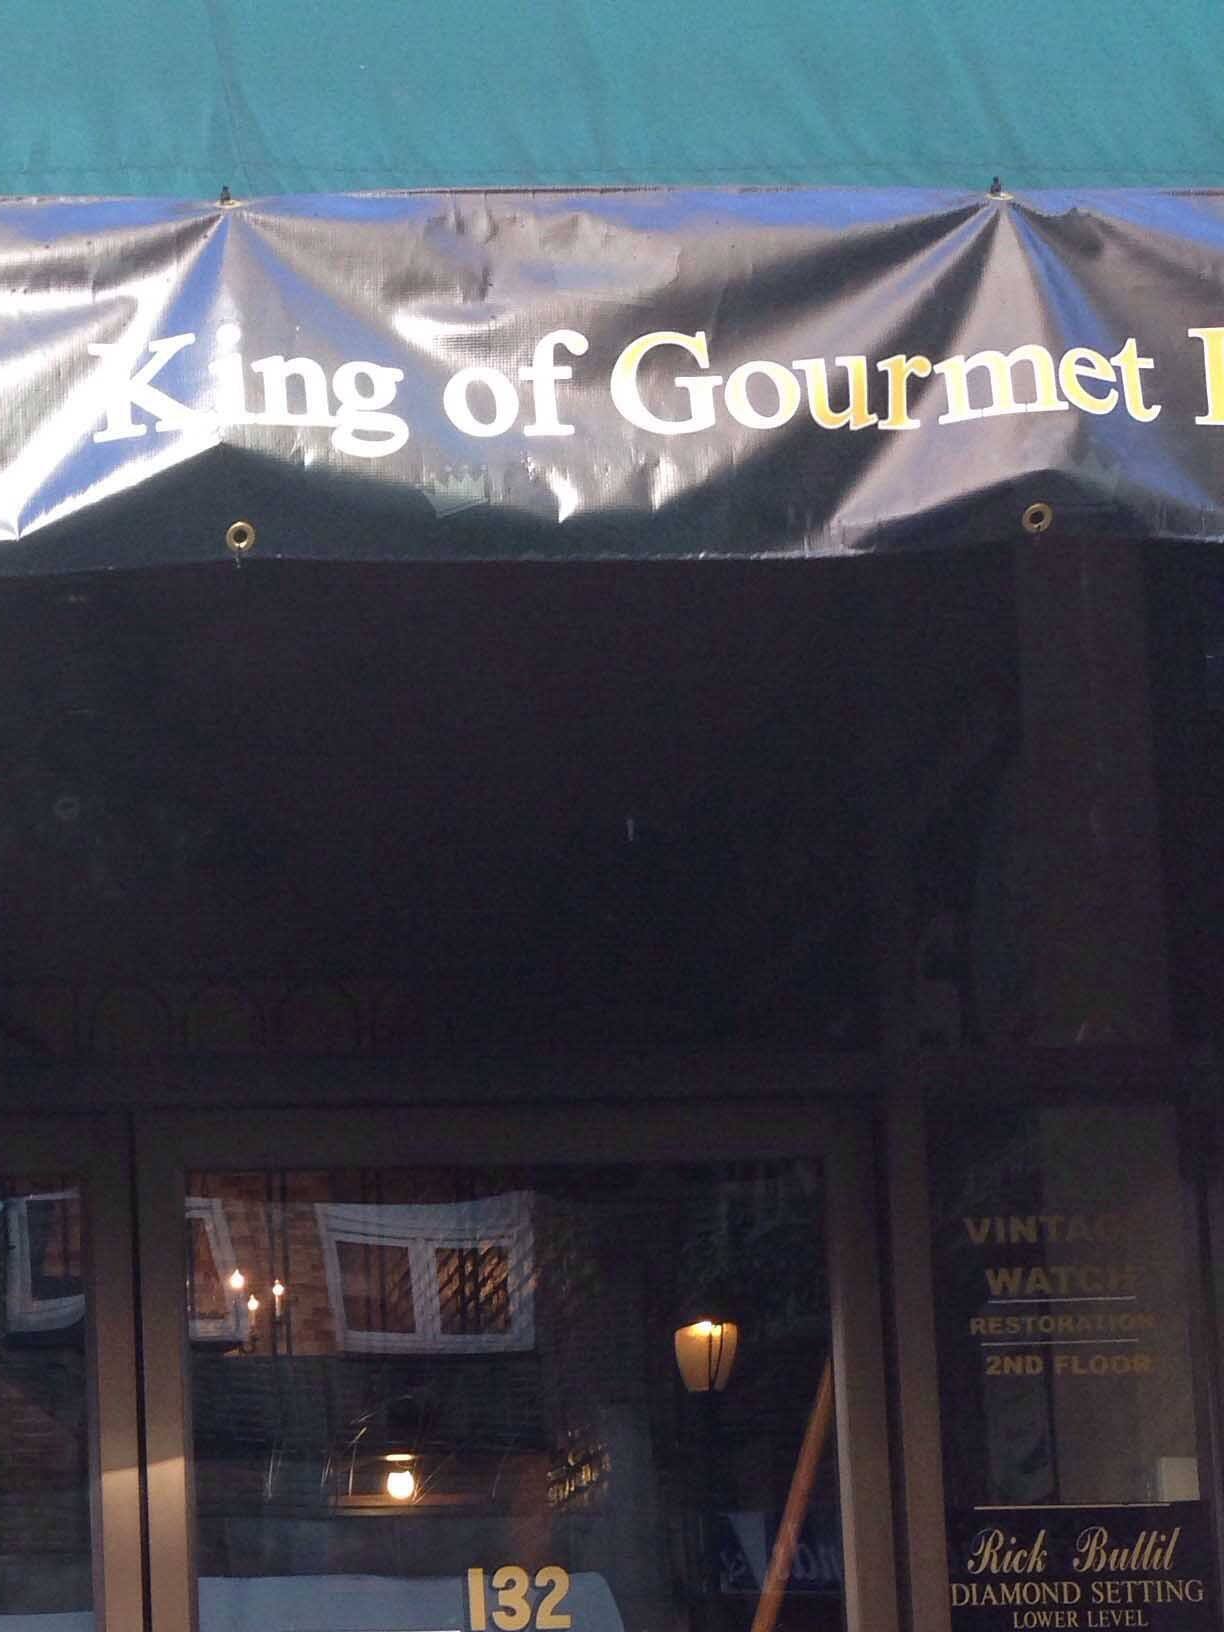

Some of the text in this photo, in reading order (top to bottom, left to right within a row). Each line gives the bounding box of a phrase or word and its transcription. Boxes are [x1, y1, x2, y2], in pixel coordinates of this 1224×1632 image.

[88, 323, 406, 461] King
[443, 327, 589, 439] of
[609, 329, 1162, 433] Gourmet
[985, 1266, 1137, 1296] WATCH
[969, 1312, 1156, 1335] RESTORATION
[984, 1353, 1154, 1376] 2ND FLOOR
[967, 1528, 1048, 1574] Rick
[467, 1565, 572, 1632] 132
[952, 1579, 1204, 1606] DIAMOND SETTING
[1013, 1609, 1149, 1629] LOWER LEVEL
